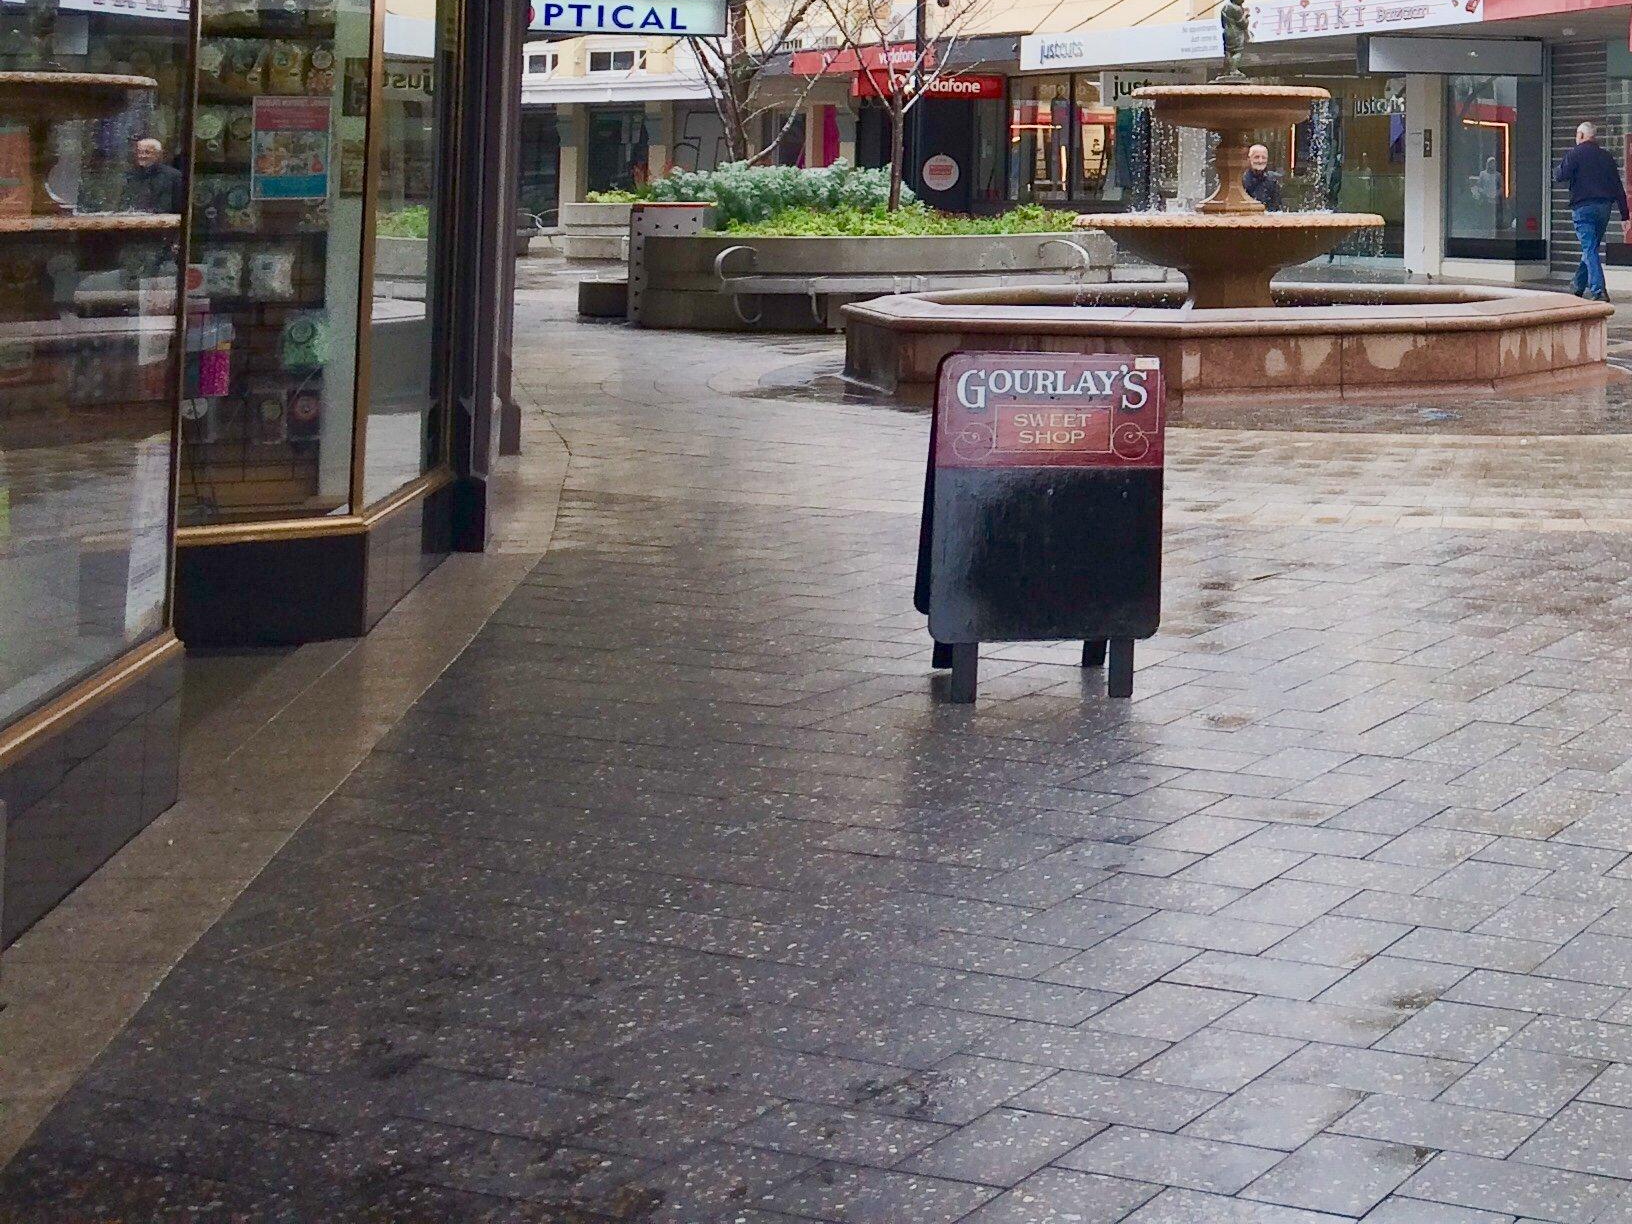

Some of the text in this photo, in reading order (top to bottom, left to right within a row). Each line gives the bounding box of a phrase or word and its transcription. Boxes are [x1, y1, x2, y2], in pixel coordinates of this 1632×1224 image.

[528, 3, 688, 30] PTICAL
[879, 46, 917, 64] vodafon
[956, 363, 1149, 410] GOURLAY'S
[1012, 413, 1093, 428] SWEET
[1018, 429, 1087, 445] SHOP
